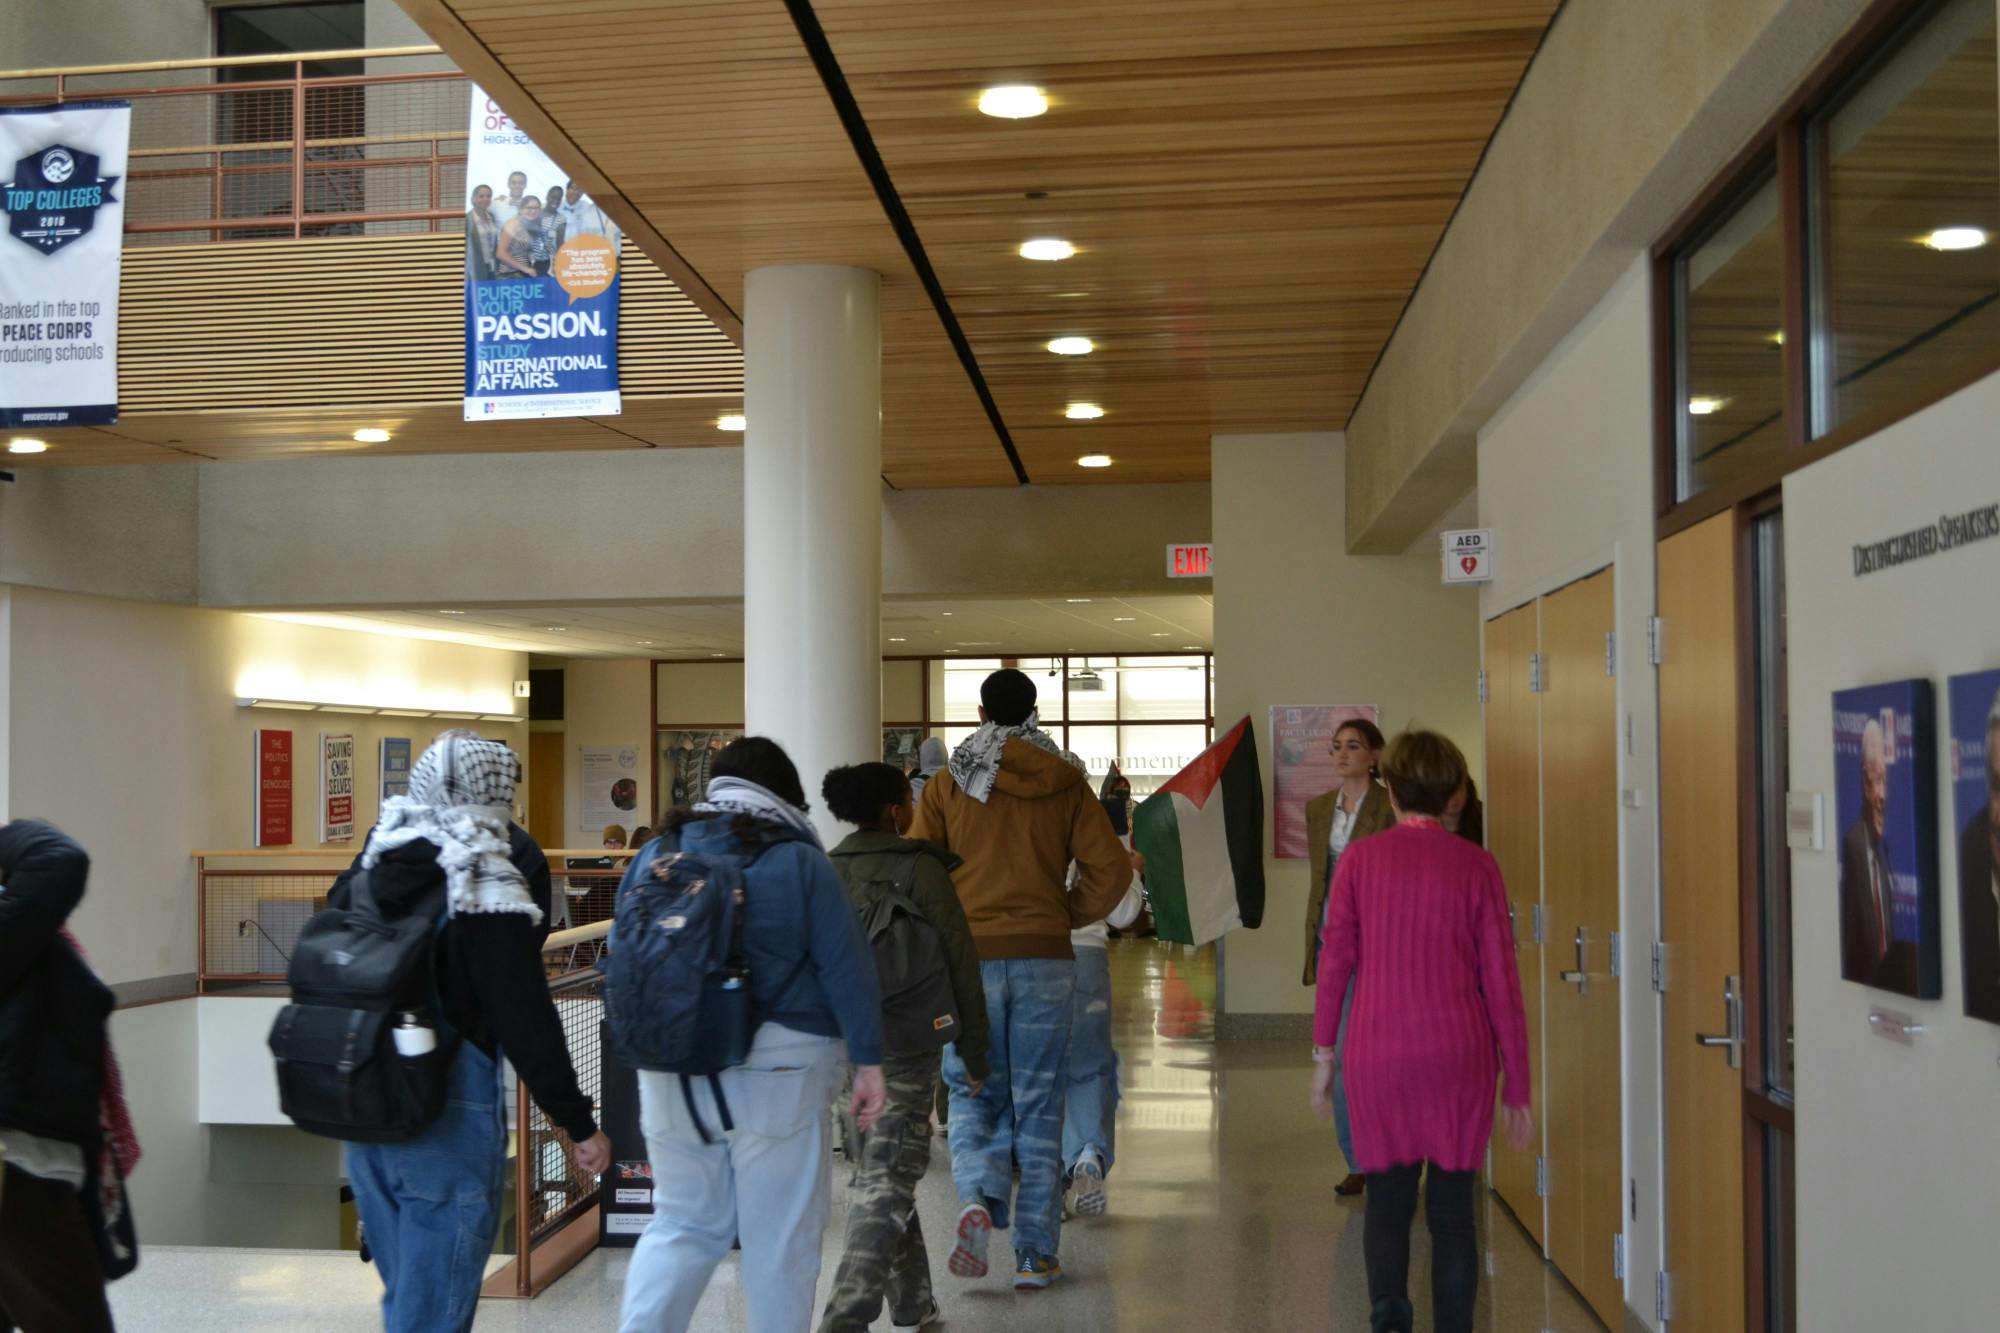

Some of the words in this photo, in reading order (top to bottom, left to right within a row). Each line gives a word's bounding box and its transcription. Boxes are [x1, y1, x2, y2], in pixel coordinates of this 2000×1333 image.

[483, 135, 511, 144] HIGH
[7, 190, 34, 211] TOP
[36, 186, 102, 210] COLLEGES
[478, 284, 544, 301] PURSUE
[43, 301, 55, 318] in
[57, 300, 77, 317] the
[80, 301, 101, 319] top
[478, 300, 524, 315] YOUR
[3, 323, 43, 342] PEACE
[46, 321, 93, 340] CORPS
[477, 311, 607, 342] PASSION.
[0, 344, 53, 364] roducing
[55, 343, 104, 361] schools
[478, 344, 531, 360] STUDY
[477, 354, 608, 375] INTERNATIONAL
[476, 372, 559, 391] AFFAIRS.
[1457, 534, 1481, 547] AED
[1852, 524, 1939, 577] DISTINGUISHED
[1938, 502, 1999, 552] SPEAKERS
[1174, 546, 1209, 574] EXIT
[264, 752, 289, 762] POLITICS
[327, 741, 352, 760] SAVING
[328, 777, 352, 795] SELVES
